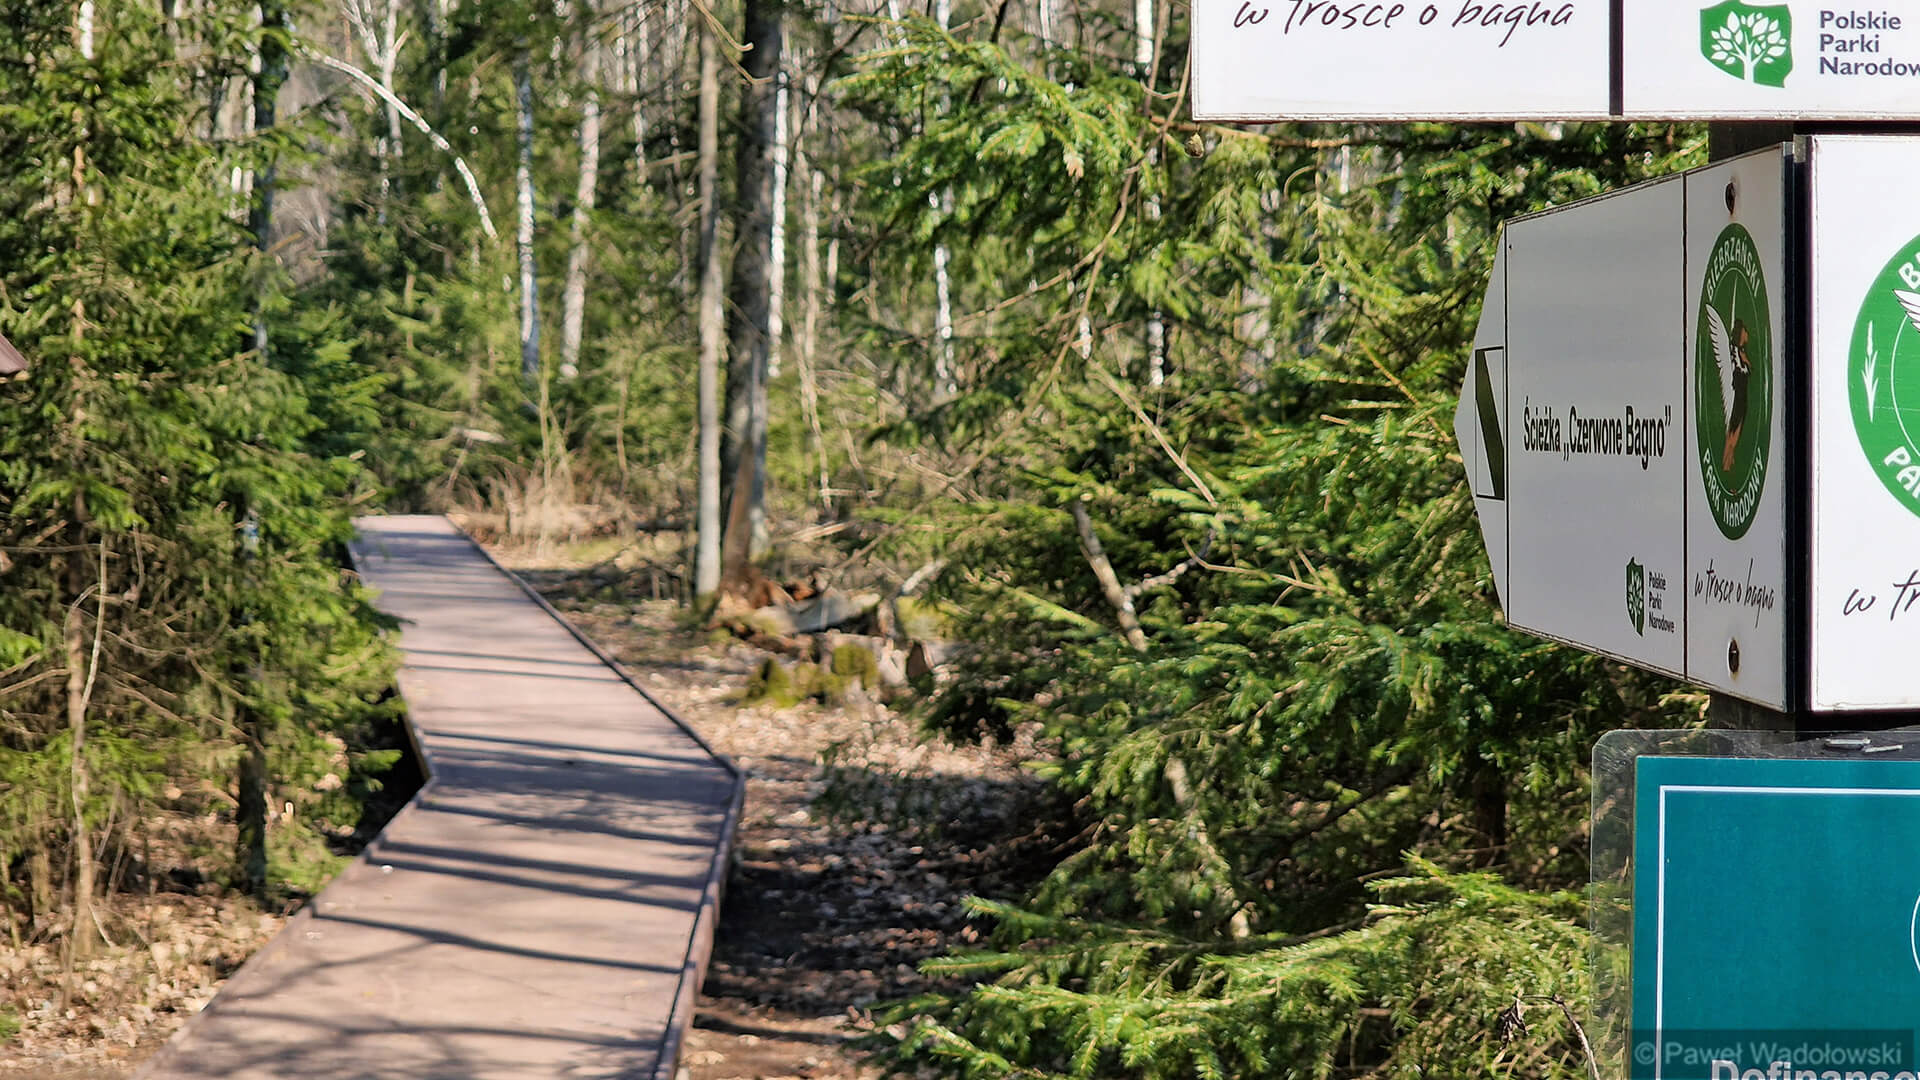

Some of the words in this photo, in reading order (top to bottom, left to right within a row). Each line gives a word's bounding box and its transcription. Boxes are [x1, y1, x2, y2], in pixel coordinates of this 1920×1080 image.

[1233, 1, 1269, 28] w
[1419, 3, 1439, 26] o
[1819, 10, 1902, 30] Polskie
[1819, 33, 1880, 53] Parki
[1706, 236, 1760, 302] BIEBRZAŃSKI
[1523, 395, 1561, 453] Ścieżka
[1703, 447, 1721, 512] PARK
[1723, 445, 1763, 528] NARODOWY
[1694, 572, 1703, 597] w
[1706, 558, 1734, 604] trosce
[1736, 582, 1742, 603] o
[1743, 558, 1774, 629] bagna
[1843, 588, 1876, 616] w
